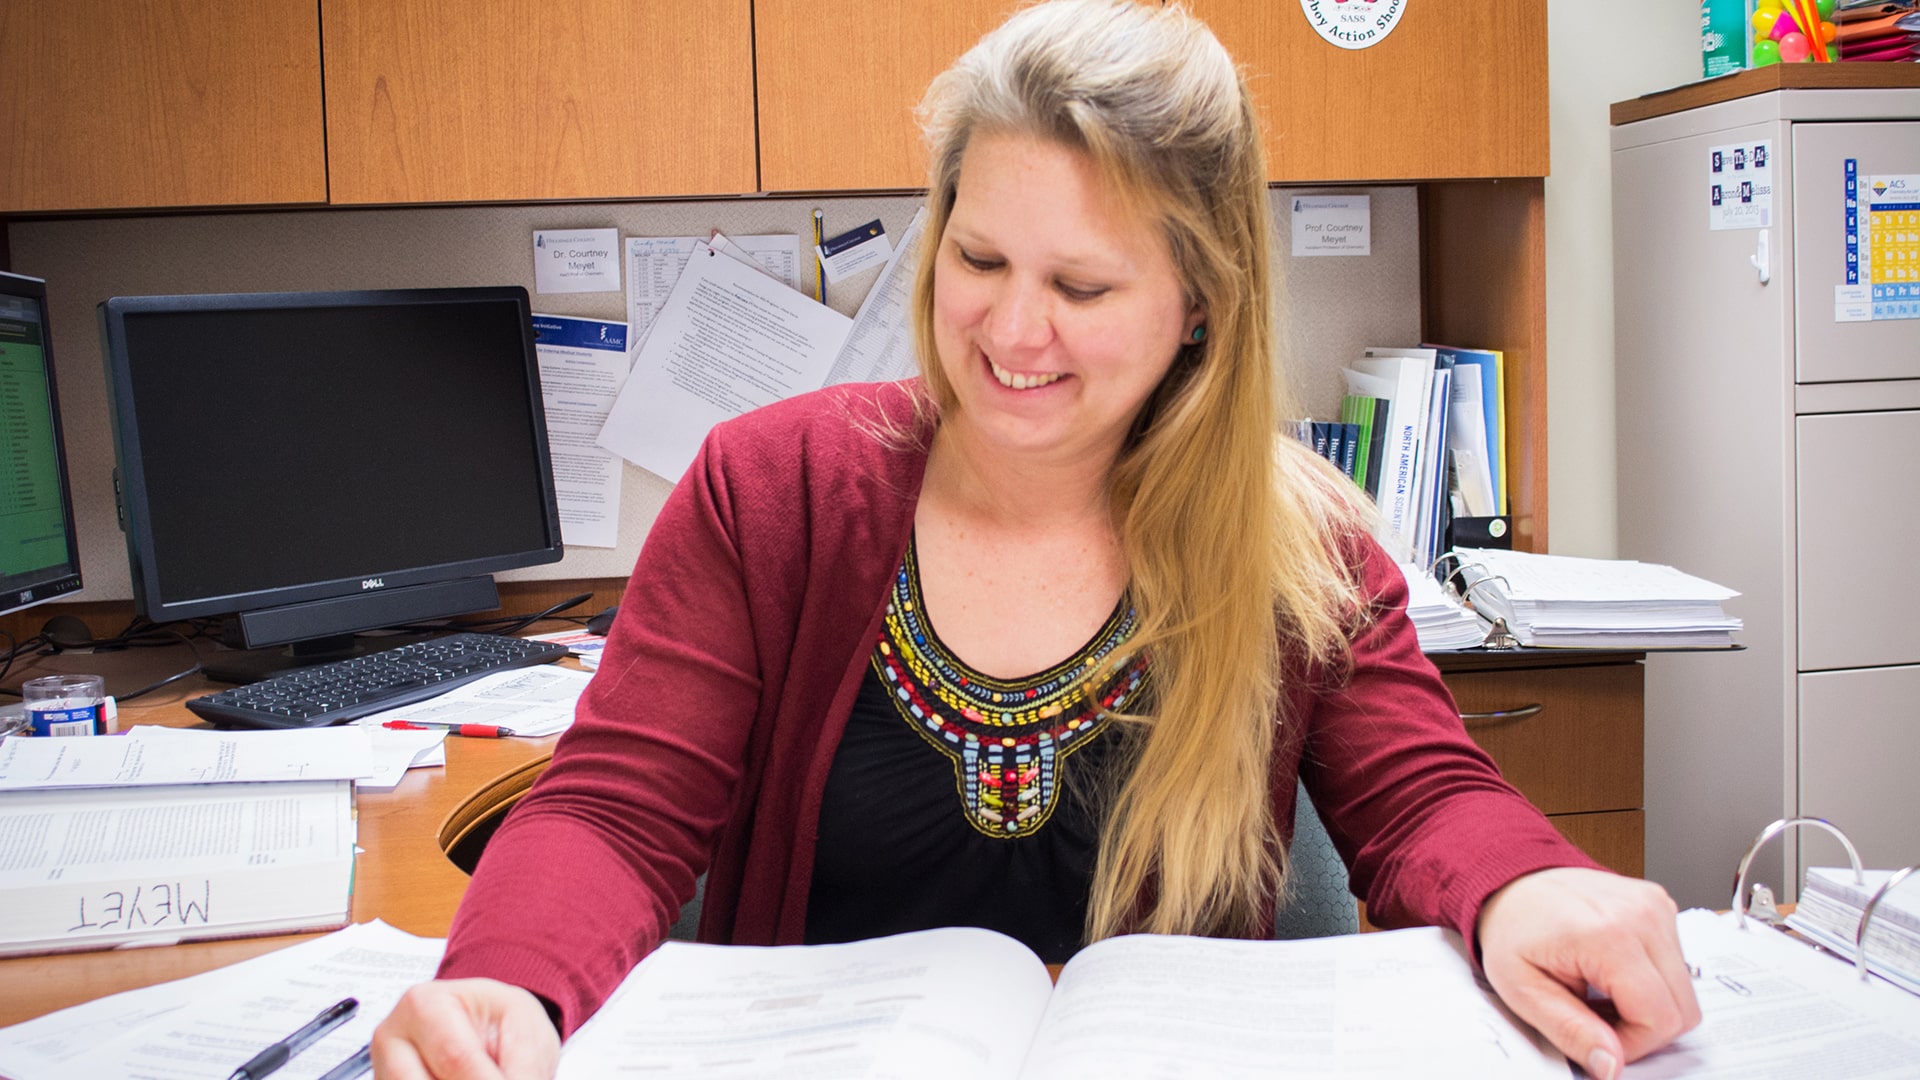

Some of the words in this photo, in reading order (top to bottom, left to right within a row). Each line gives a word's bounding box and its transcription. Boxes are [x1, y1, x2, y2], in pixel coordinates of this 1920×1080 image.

[1307, 0, 1328, 27] boy
[1328, 25, 1376, 42] Action
[1340, 15, 1366, 23] SASS
[1889, 180, 1906, 189] ACS
[1326, 223, 1364, 233] Courtney
[1321, 235, 1347, 245] Meyet
[553, 250, 566, 259] Dr.
[568, 249, 609, 259] Courtney
[568, 261, 595, 271] Meyet
[603, 338, 624, 346] AAMC
[1401, 425, 1413, 452] NORTH
[1396, 453, 1410, 495] AMERICAN
[1391, 496, 1404, 537] SCIENTIF
[362, 578, 385, 590] DELL
[67, 880, 209, 932] MEYET
